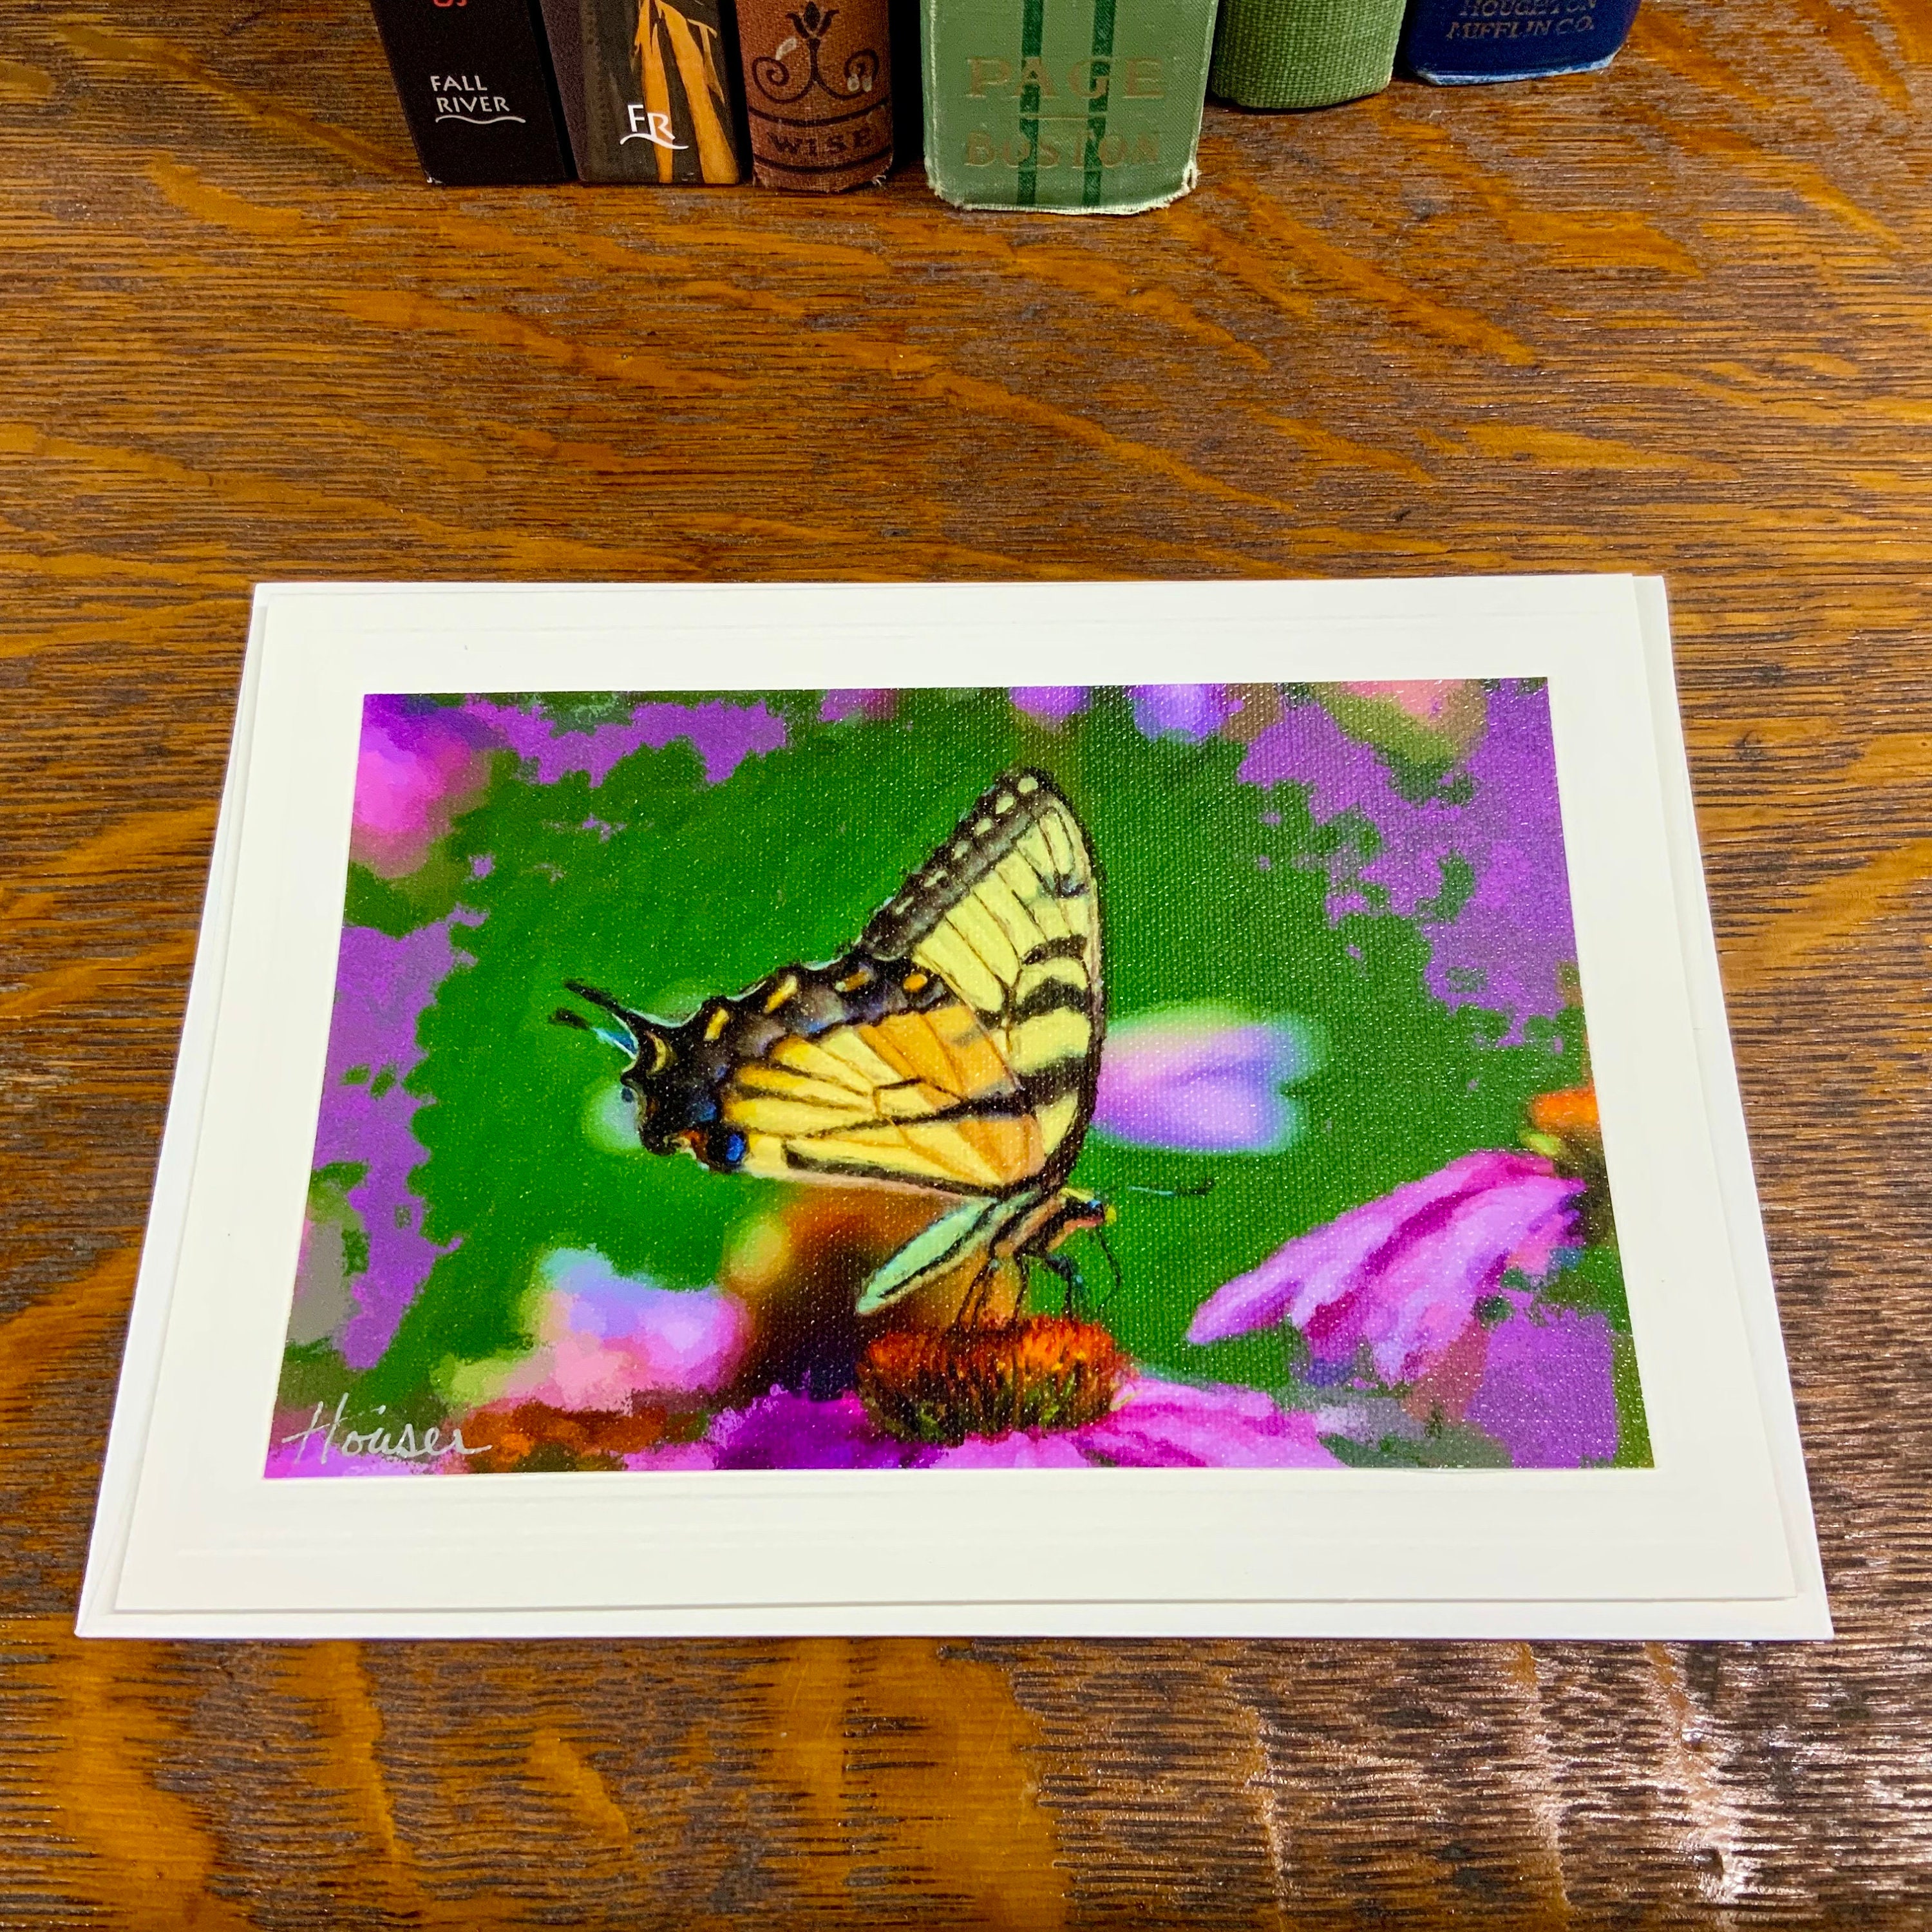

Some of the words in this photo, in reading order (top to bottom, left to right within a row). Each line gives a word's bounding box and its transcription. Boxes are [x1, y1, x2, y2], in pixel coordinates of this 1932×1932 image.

[430, 75, 488, 92] FALL
[966, 57, 1166, 99] PAGE
[436, 96, 511, 113] RIVER
[627, 104, 676, 140] FR
[766, 128, 872, 157] WISE
[964, 129, 1160, 168] BOSTON
